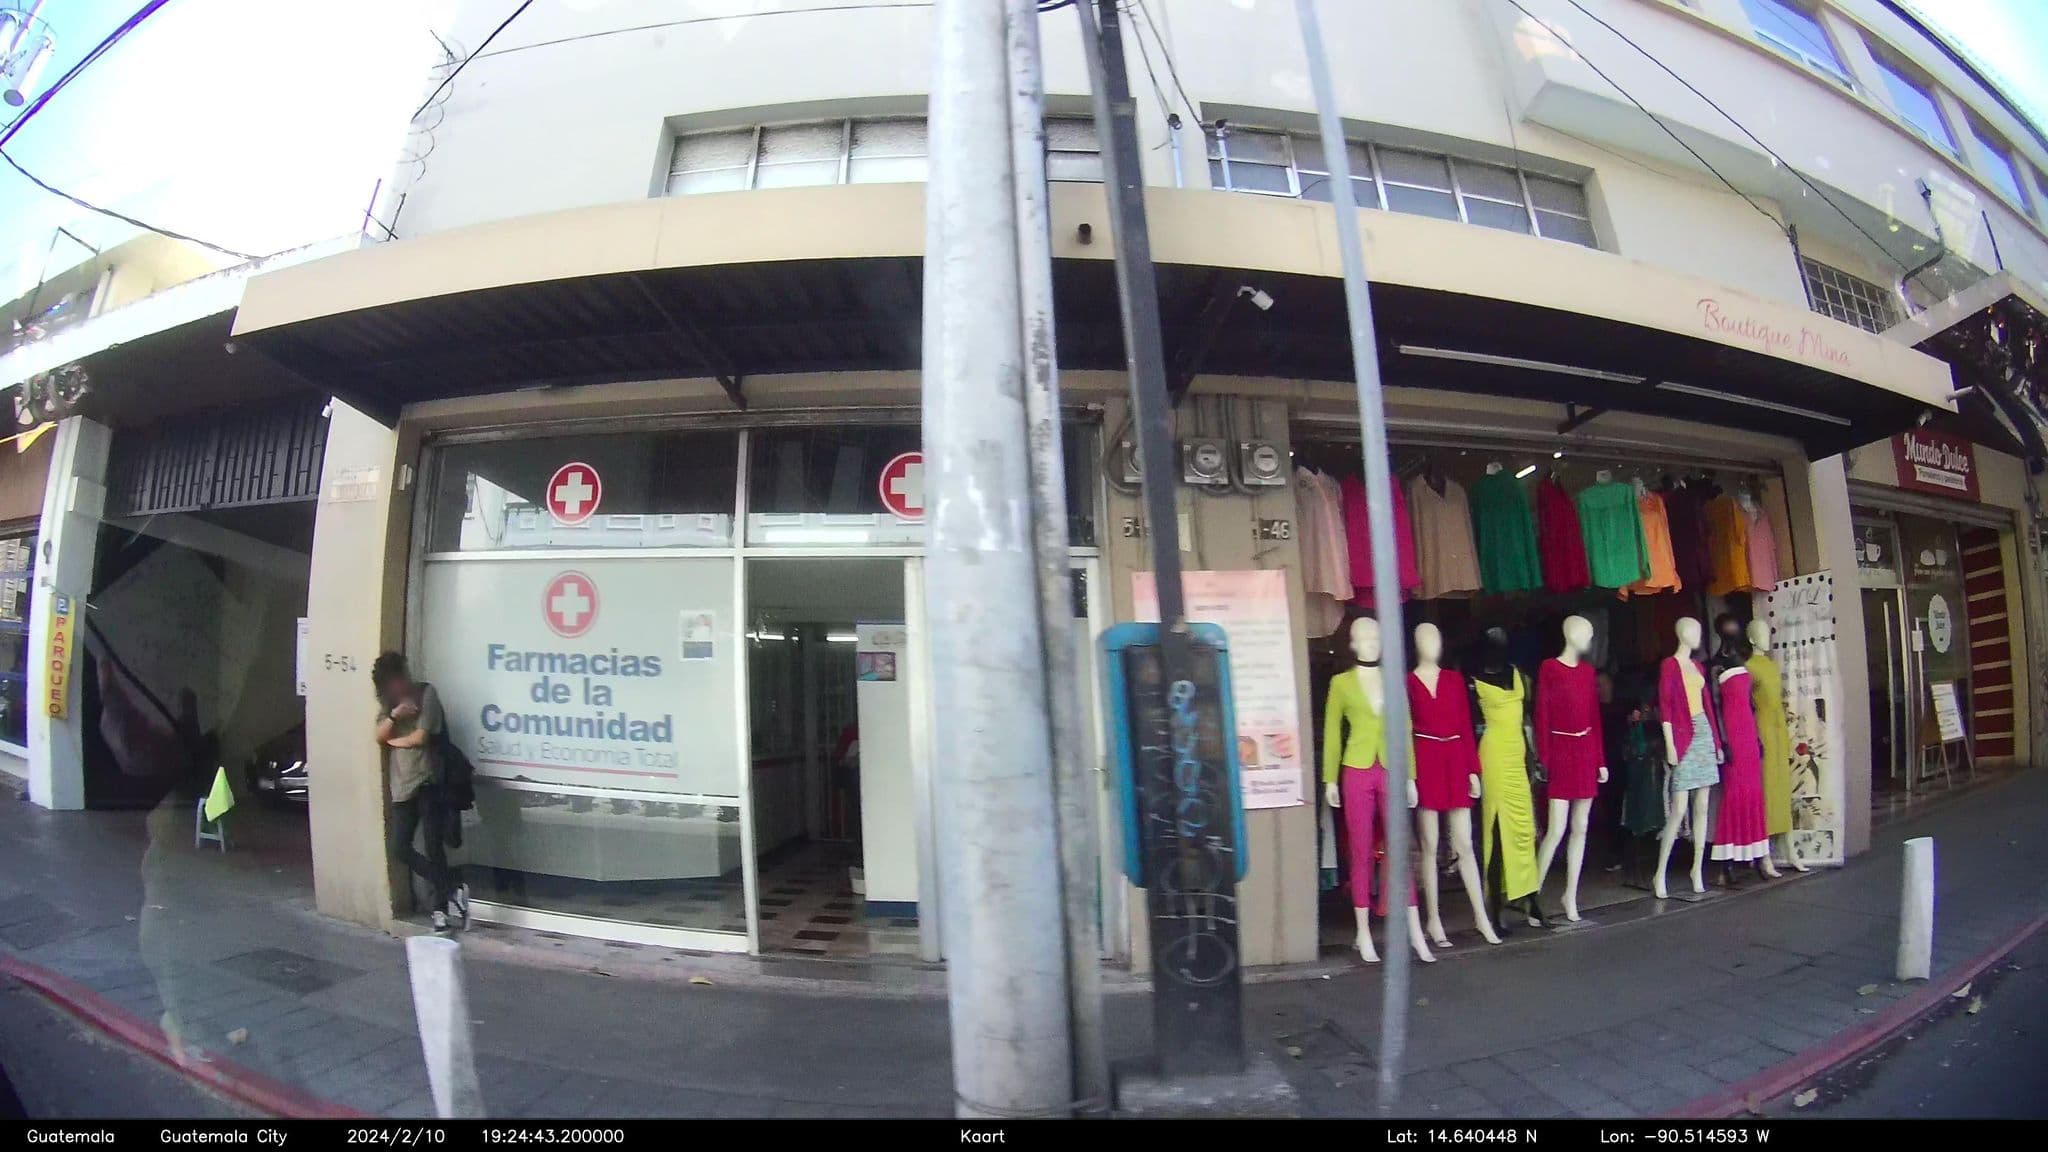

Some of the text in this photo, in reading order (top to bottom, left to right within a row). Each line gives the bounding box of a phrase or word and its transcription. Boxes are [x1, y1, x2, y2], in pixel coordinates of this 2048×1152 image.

[1697, 299, 1793, 353] Boutique
[1903, 432, 1969, 473] Mundo Dulce
[487, 643, 662, 678] Farmacias
[530, 676, 612, 706] de la
[480, 703, 673, 743] Comunidad
[480, 736, 522, 756] Salud
[634, 746, 679, 769] Total
